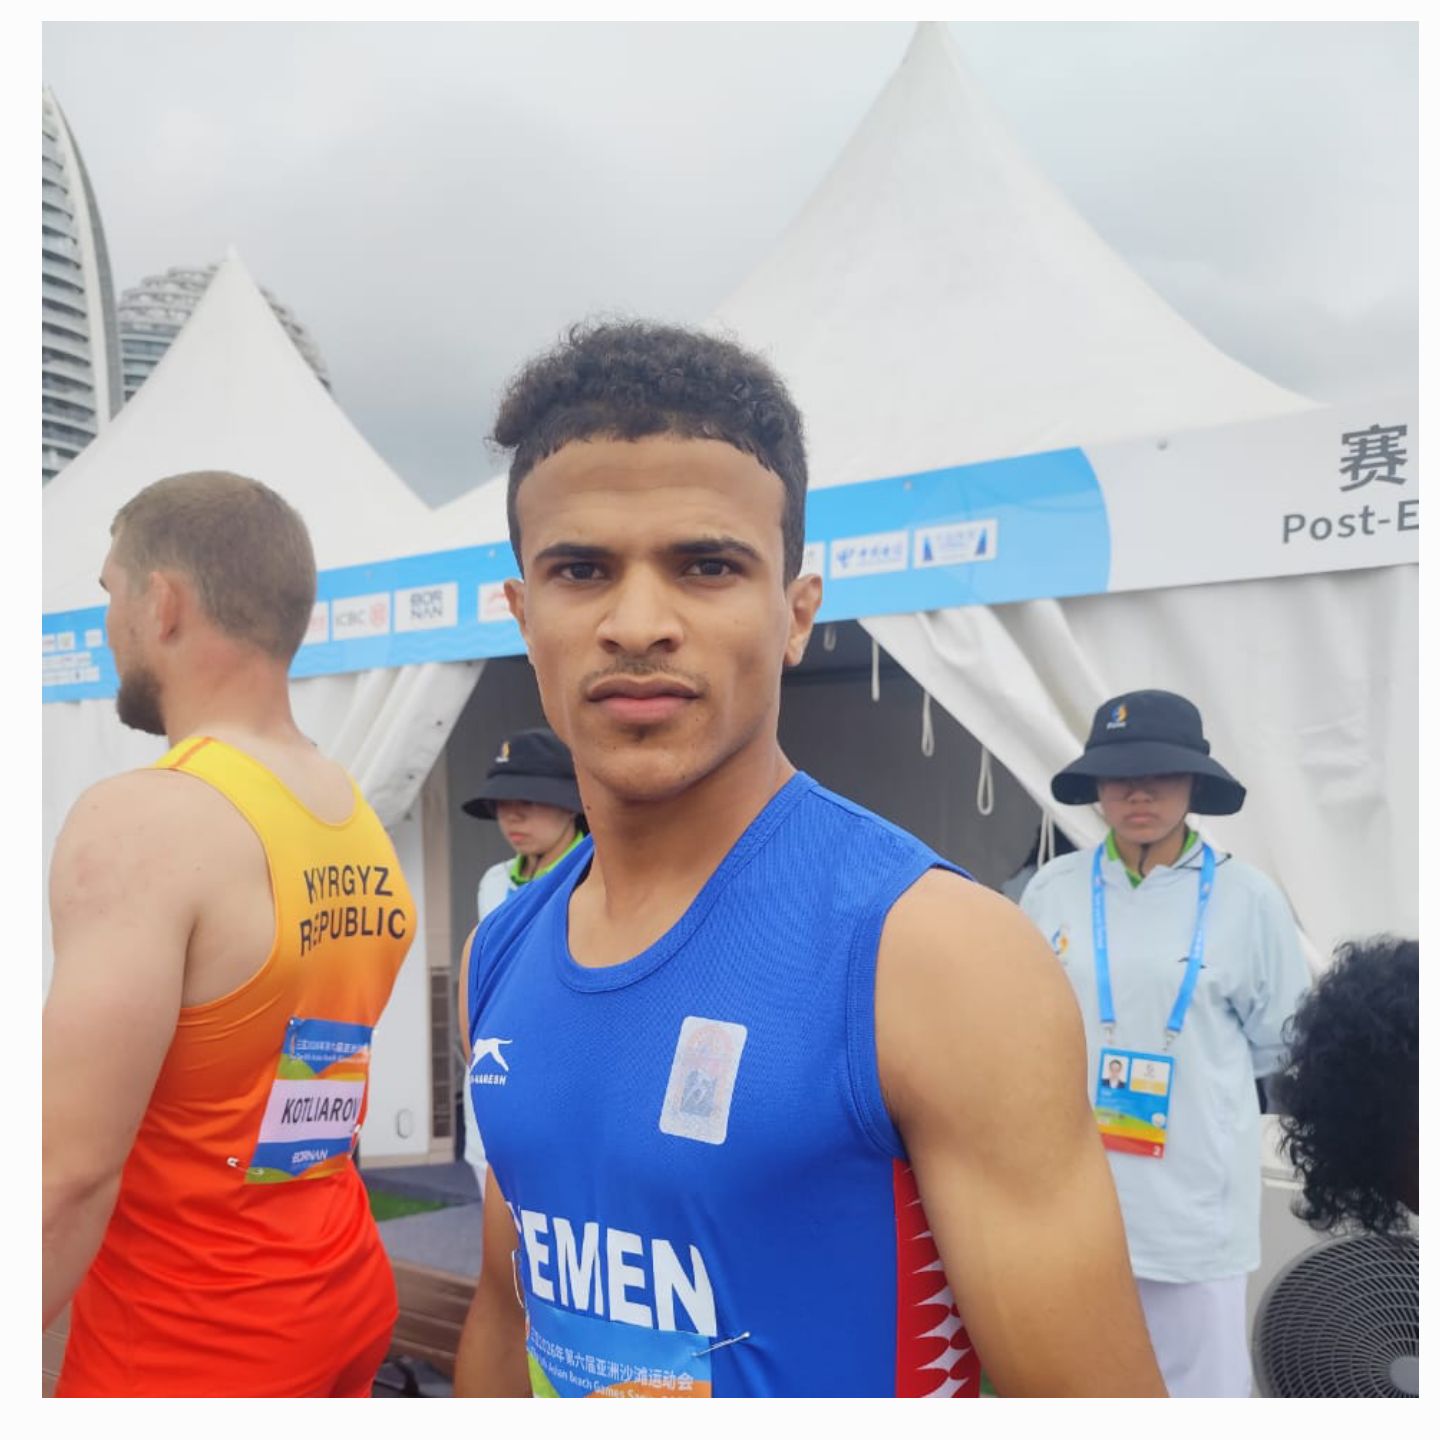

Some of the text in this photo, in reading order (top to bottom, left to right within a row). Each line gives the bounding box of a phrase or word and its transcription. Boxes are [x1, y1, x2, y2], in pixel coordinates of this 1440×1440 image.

[1339, 424, 1409, 492] 赛
[1282, 498, 1420, 545] Post-E
[409, 590, 443, 606] BOR
[410, 605, 443, 620] NAN
[304, 865, 393, 905] KYRGYZ
[299, 907, 407, 957] REPUBLIC
